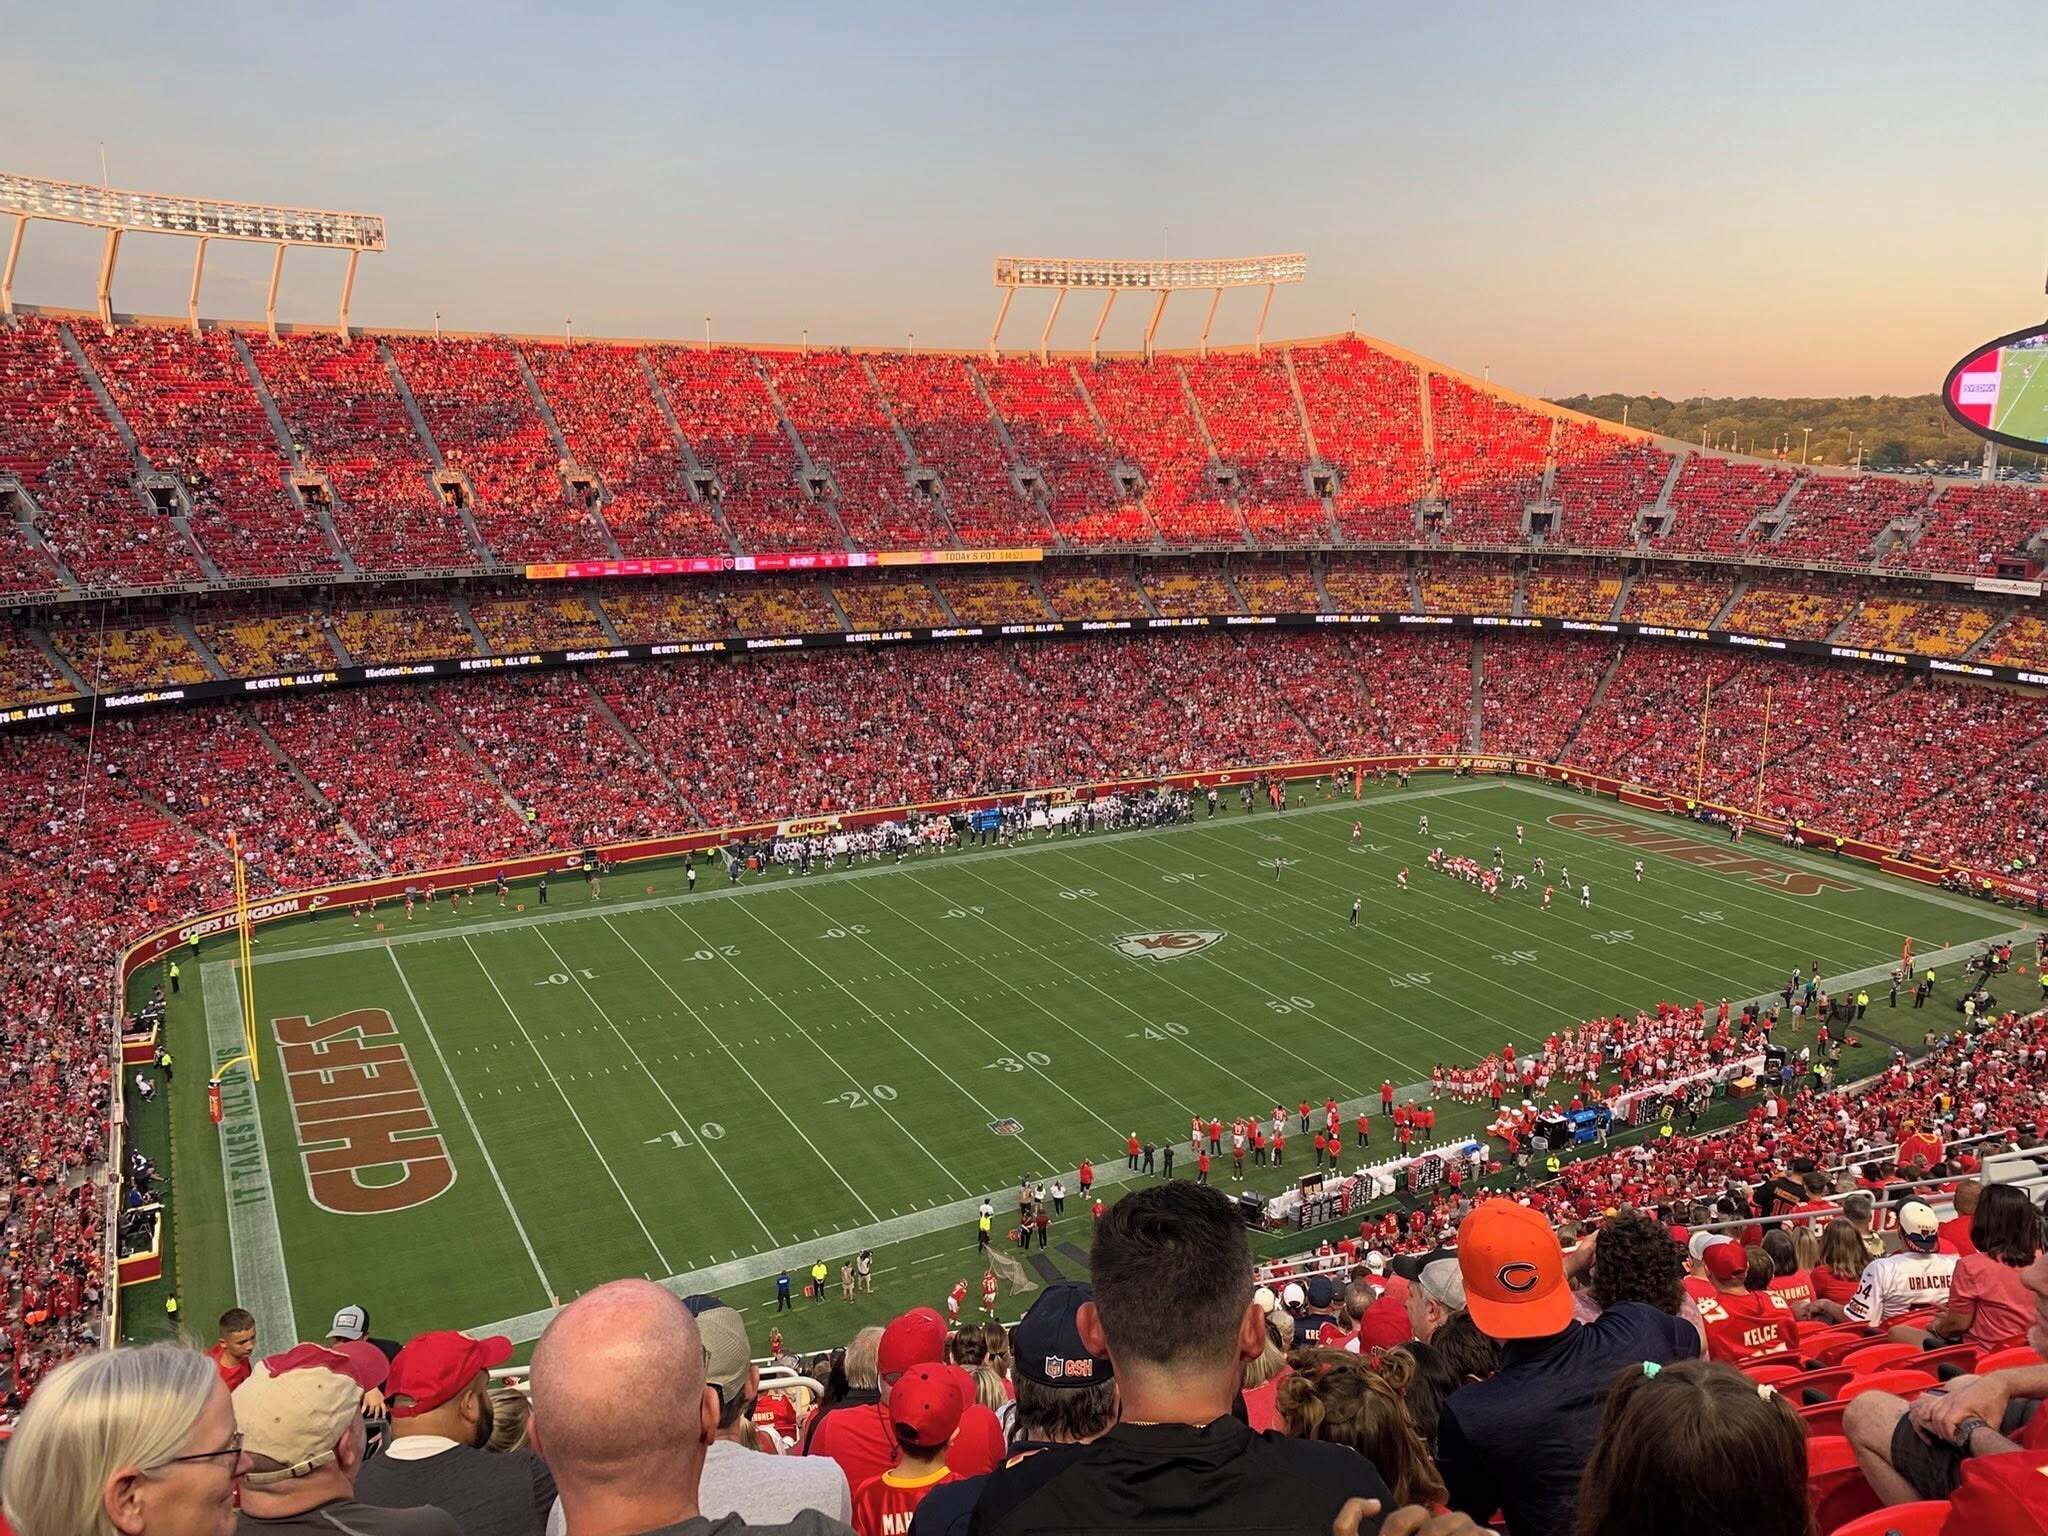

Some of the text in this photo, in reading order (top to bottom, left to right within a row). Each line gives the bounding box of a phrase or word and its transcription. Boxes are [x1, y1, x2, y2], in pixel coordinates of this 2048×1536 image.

[945, 553, 978, 561] TODAY'S
[980, 552, 996, 560] POT
[1775, 561, 1805, 569] CARSON
[1832, 566, 1872, 574] GONZALEZ
[308, 576, 337, 584] OKOYE
[1902, 571, 1932, 579] WATERS
[163, 585, 187, 593] STILL
[227, 580, 270, 589] BURRUSS
[18, 594, 58, 604] CHERRY
[101, 590, 121, 598] HILL
[1002, 626, 1010, 634] HE
[1010, 625, 1025, 633] GETS
[1036, 624, 1046, 632] ALL
[1482, 617, 1498, 625] GETS
[1510, 618, 1522, 626] ALL
[846, 634, 855, 642] HE
[882, 632, 893, 640] ALL
[1649, 627, 1665, 635] GETS
[1677, 629, 1690, 638] ALL
[1690, 631, 1698, 639] OF
[662, 645, 679, 654] GETS
[692, 643, 705, 651] ALL
[1730, 635, 1786, 648] HeGetsUs.com
[460, 661, 471, 670] HE
[472, 660, 491, 669] GETS
[505, 657, 519, 666] ALL
[519, 656, 530, 665] OF
[566, 650, 629, 661] HeGetsUs.com
[1831, 648, 1841, 656] HE
[1842, 648, 1859, 658] GETS
[1871, 652, 1886, 662] ALL
[1886, 653, 1896, 663] OF
[365, 665, 434, 678] HeGetsUs.com
[1929, 659, 1993, 676] HeGetsUs.com
[245, 681, 257, 690] HE
[258, 678, 280, 689] GETS
[296, 675, 313, 685] ALL
[313, 674, 325, 683] OF
[2018, 672, 2029, 681] HE
[105, 690, 184, 707] HeGetsUs.com
[11, 710, 26, 721] US.
[27, 706, 46, 718] ALL
[46, 705, 59, 716] OF
[59, 703, 75, 713] US.
[789, 821, 827, 834] CHIEFS
[1546, 813, 1864, 897] CHIEFS
[1160, 872, 1199, 884] 40
[1058, 888, 1100, 900] 50
[948, 904, 986, 920] 40
[1681, 910, 1724, 926] 10
[178, 917, 223, 941] CHIEFS
[825, 923, 872, 939] 30
[1593, 928, 1635, 946] 20
[694, 944, 742, 963] 20
[1492, 949, 1536, 967] 30
[548, 966, 600, 986] 10
[1388, 971, 1432, 991] 40
[1265, 995, 1316, 1016] 50
[1143, 1022, 1190, 1044] 40
[998, 1051, 1052, 1074] 30
[221, 1089, 254, 1118] ALL
[839, 1084, 899, 1110] 20
[270, 1007, 458, 1215] CHIEFS
[661, 1121, 727, 1150] 10
[224, 1123, 263, 1181] TAKES
[233, 1186, 267, 1207] IT
[1743, 1324, 1778, 1347] KELCE
